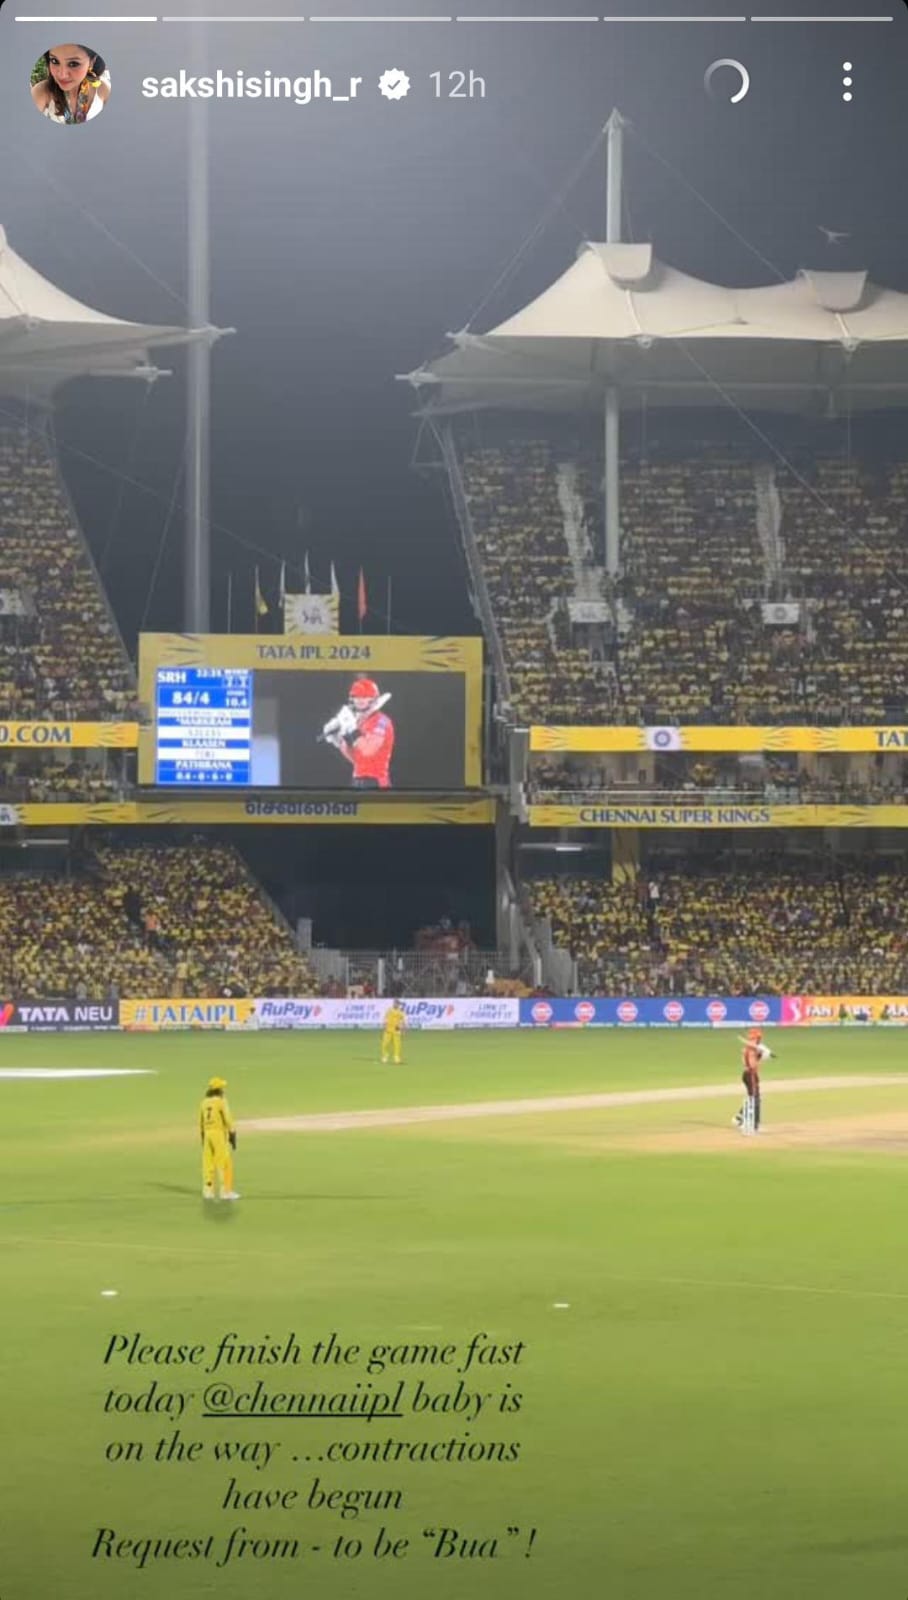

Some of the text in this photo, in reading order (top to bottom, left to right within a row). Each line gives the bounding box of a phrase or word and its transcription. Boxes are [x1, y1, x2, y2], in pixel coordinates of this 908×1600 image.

[256, 645, 371, 659] TATA IPL 2024
[157, 671, 187, 684] SRH
[172, 691, 211, 705] 84/4
[579, 807, 770, 824] CHENNAI SUPER KINGS
[18, 1006, 113, 1022] TATA NEU
[135, 1004, 237, 1023] #TATAIPL
[261, 1002, 313, 1020] RuPay
